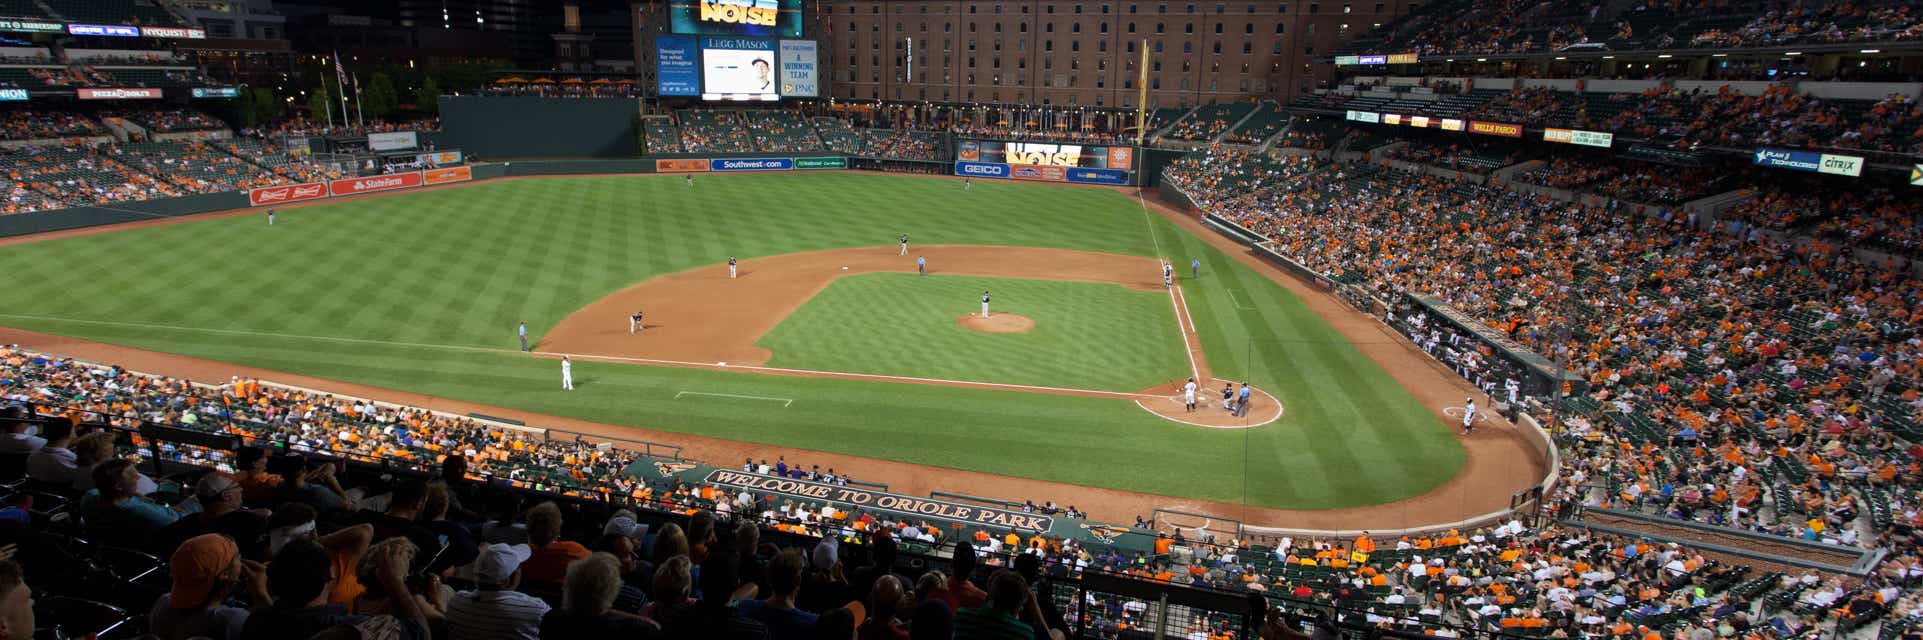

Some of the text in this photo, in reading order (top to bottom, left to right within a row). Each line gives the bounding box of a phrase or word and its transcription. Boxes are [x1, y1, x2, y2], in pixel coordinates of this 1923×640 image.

[700, 2, 777, 26] NOISE
[709, 39, 768, 49] LEGG MASON
[791, 71, 808, 79] TEAM
[1473, 123, 1517, 134] WELLS FARGO
[965, 164, 1001, 175] GEICO
[716, 470, 1047, 532] WELCOME TO ORIOLE PARK
